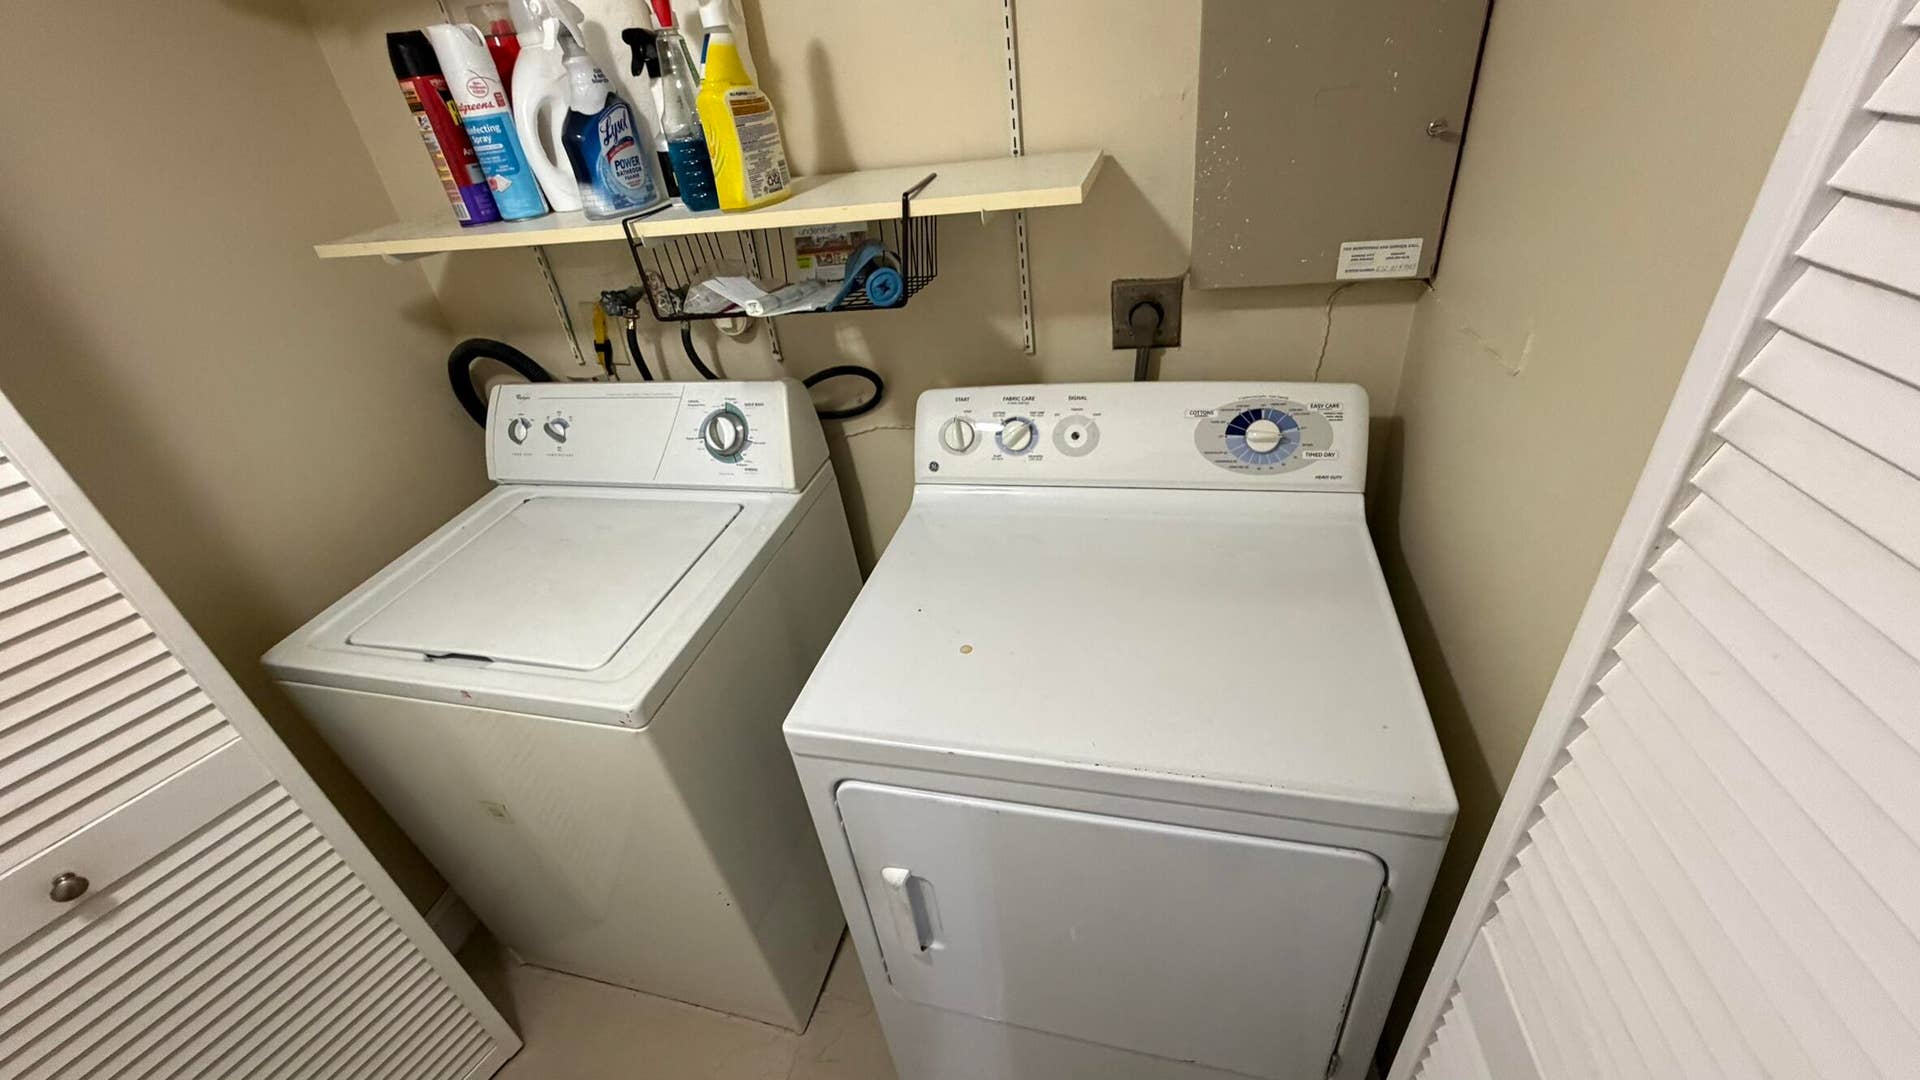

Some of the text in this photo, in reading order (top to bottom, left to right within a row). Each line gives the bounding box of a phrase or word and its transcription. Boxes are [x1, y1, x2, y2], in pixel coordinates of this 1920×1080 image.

[459, 101, 495, 114] greens
[600, 111, 629, 146] Lysol
[614, 155, 641, 171] POWER
